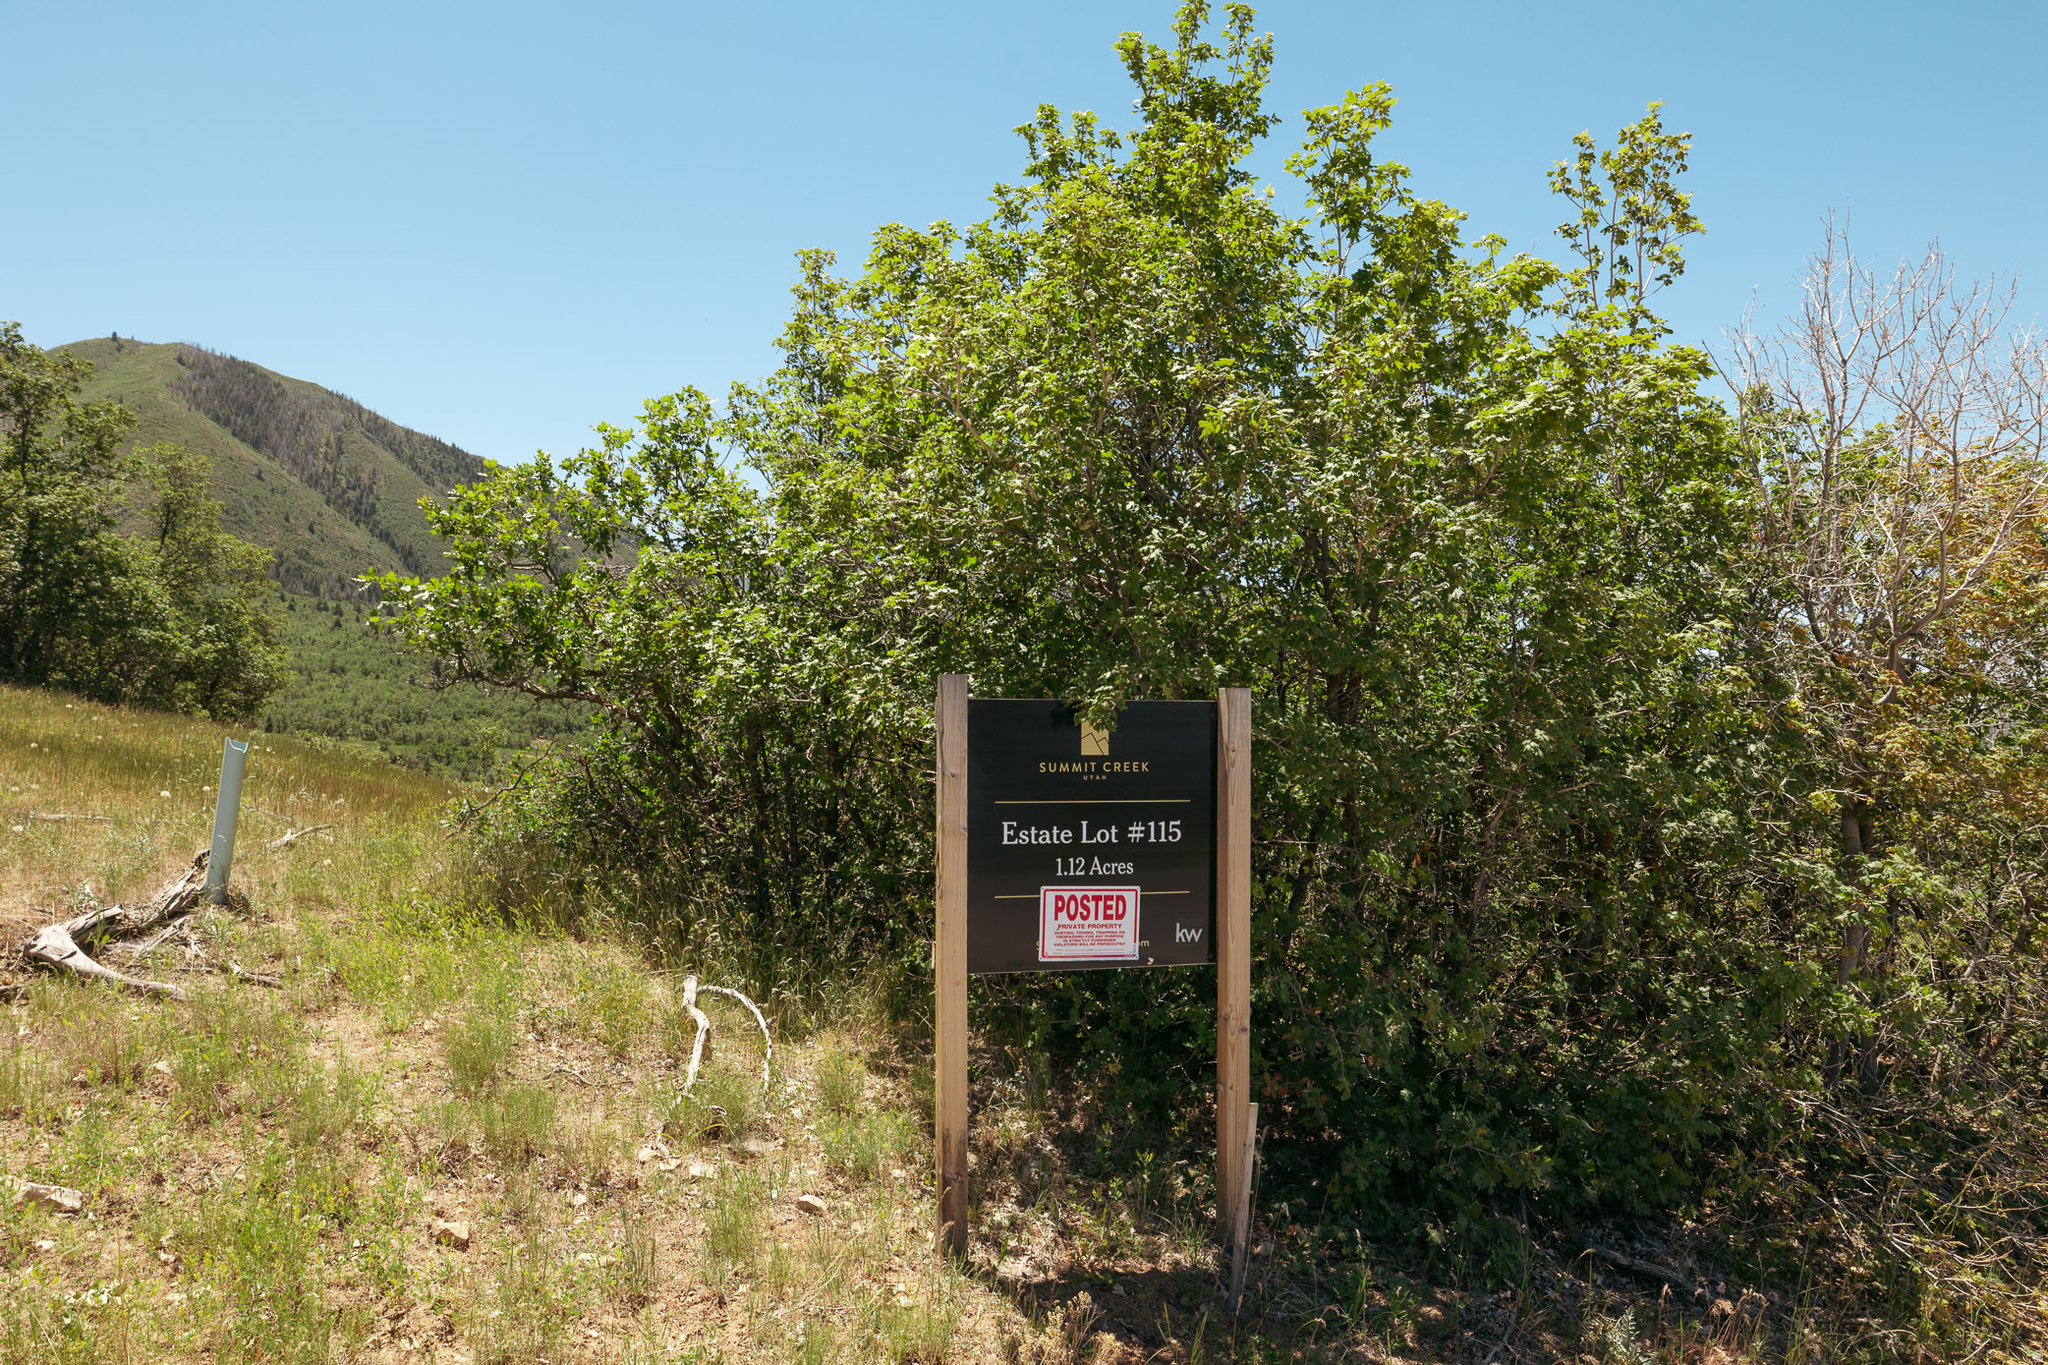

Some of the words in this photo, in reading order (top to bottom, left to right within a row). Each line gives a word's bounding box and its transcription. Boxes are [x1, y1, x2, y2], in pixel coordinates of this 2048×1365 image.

[1039, 762, 1097, 773] SUMMIT
[1102, 761, 1150, 773] CREEK
[1002, 821, 1073, 845] Estate
[1080, 820, 1119, 844] Lot
[1127, 820, 1182, 843] #115
[1056, 857, 1085, 876] 1.12
[1089, 856, 1134, 875] Acres
[1054, 894, 1127, 921] POSTED
[1175, 922, 1203, 943] kw
